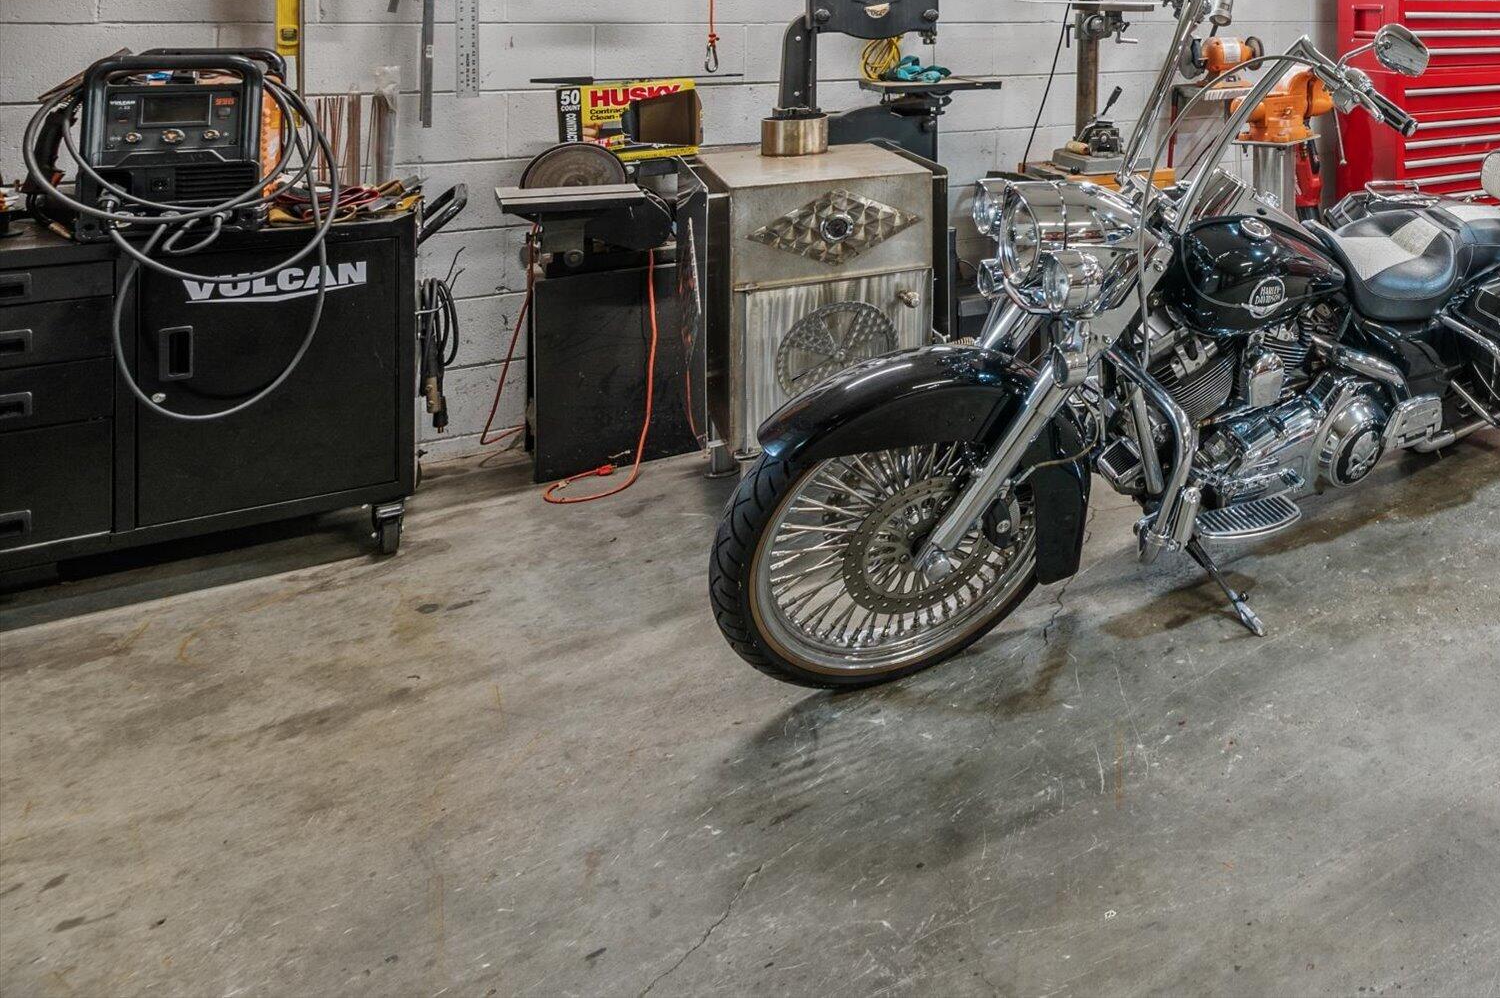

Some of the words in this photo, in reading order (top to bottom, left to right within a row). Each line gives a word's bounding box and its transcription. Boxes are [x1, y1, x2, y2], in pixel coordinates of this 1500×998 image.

[560, 89, 581, 105] 50
[560, 104, 581, 112] COUNT
[565, 113, 578, 143] CONTRACT
[182, 260, 367, 301] VULCAN
